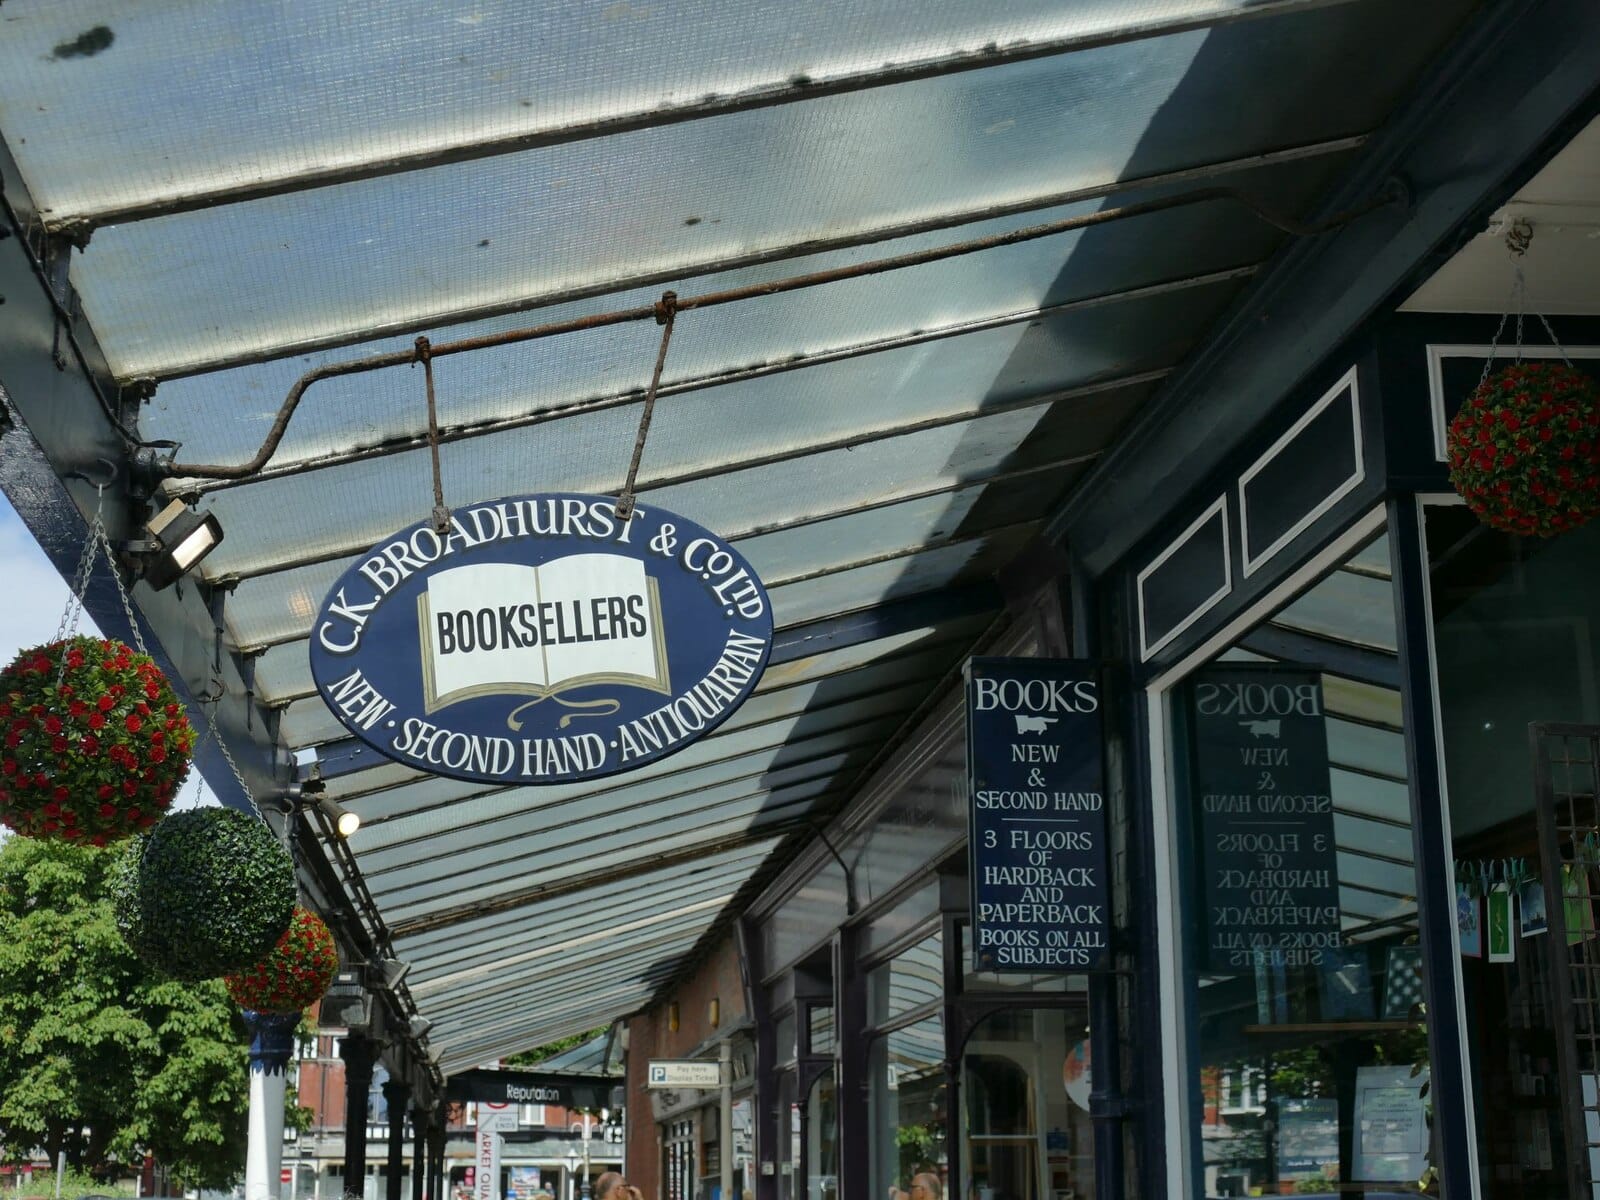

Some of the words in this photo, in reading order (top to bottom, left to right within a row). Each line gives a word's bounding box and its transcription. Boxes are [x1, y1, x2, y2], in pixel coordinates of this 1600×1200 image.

[359, 499, 645, 595] BROADHURST
[650, 523, 677, 556] &
[437, 594, 648, 655] BOOKSELLERS
[327, 669, 396, 731] NEW
[393, 717, 515, 776] SECOND
[521, 733, 606, 775] HAND
[620, 629, 767, 762] ANTIQUARIAN
[975, 678, 1098, 713] BOOKS
[1012, 744, 1060, 763] NEW
[1028, 767, 1047, 787] &
[976, 791, 1048, 810] SECOND
[1054, 792, 1103, 811] HAND
[984, 829, 998, 849] 3
[1011, 830, 1093, 850] FLOORS
[1028, 850, 1053, 866] OF
[984, 866, 1096, 887] HARDBACK
[1020, 887, 1064, 904] AND
[979, 903, 1102, 924] PAPERBACK
[980, 928, 1040, 946] BOOKS
[1045, 930, 1069, 947] ON
[1073, 931, 1106, 948] ALL
[997, 947, 1090, 965] SUBJECTS
[506, 1083, 560, 1103] Reputation
